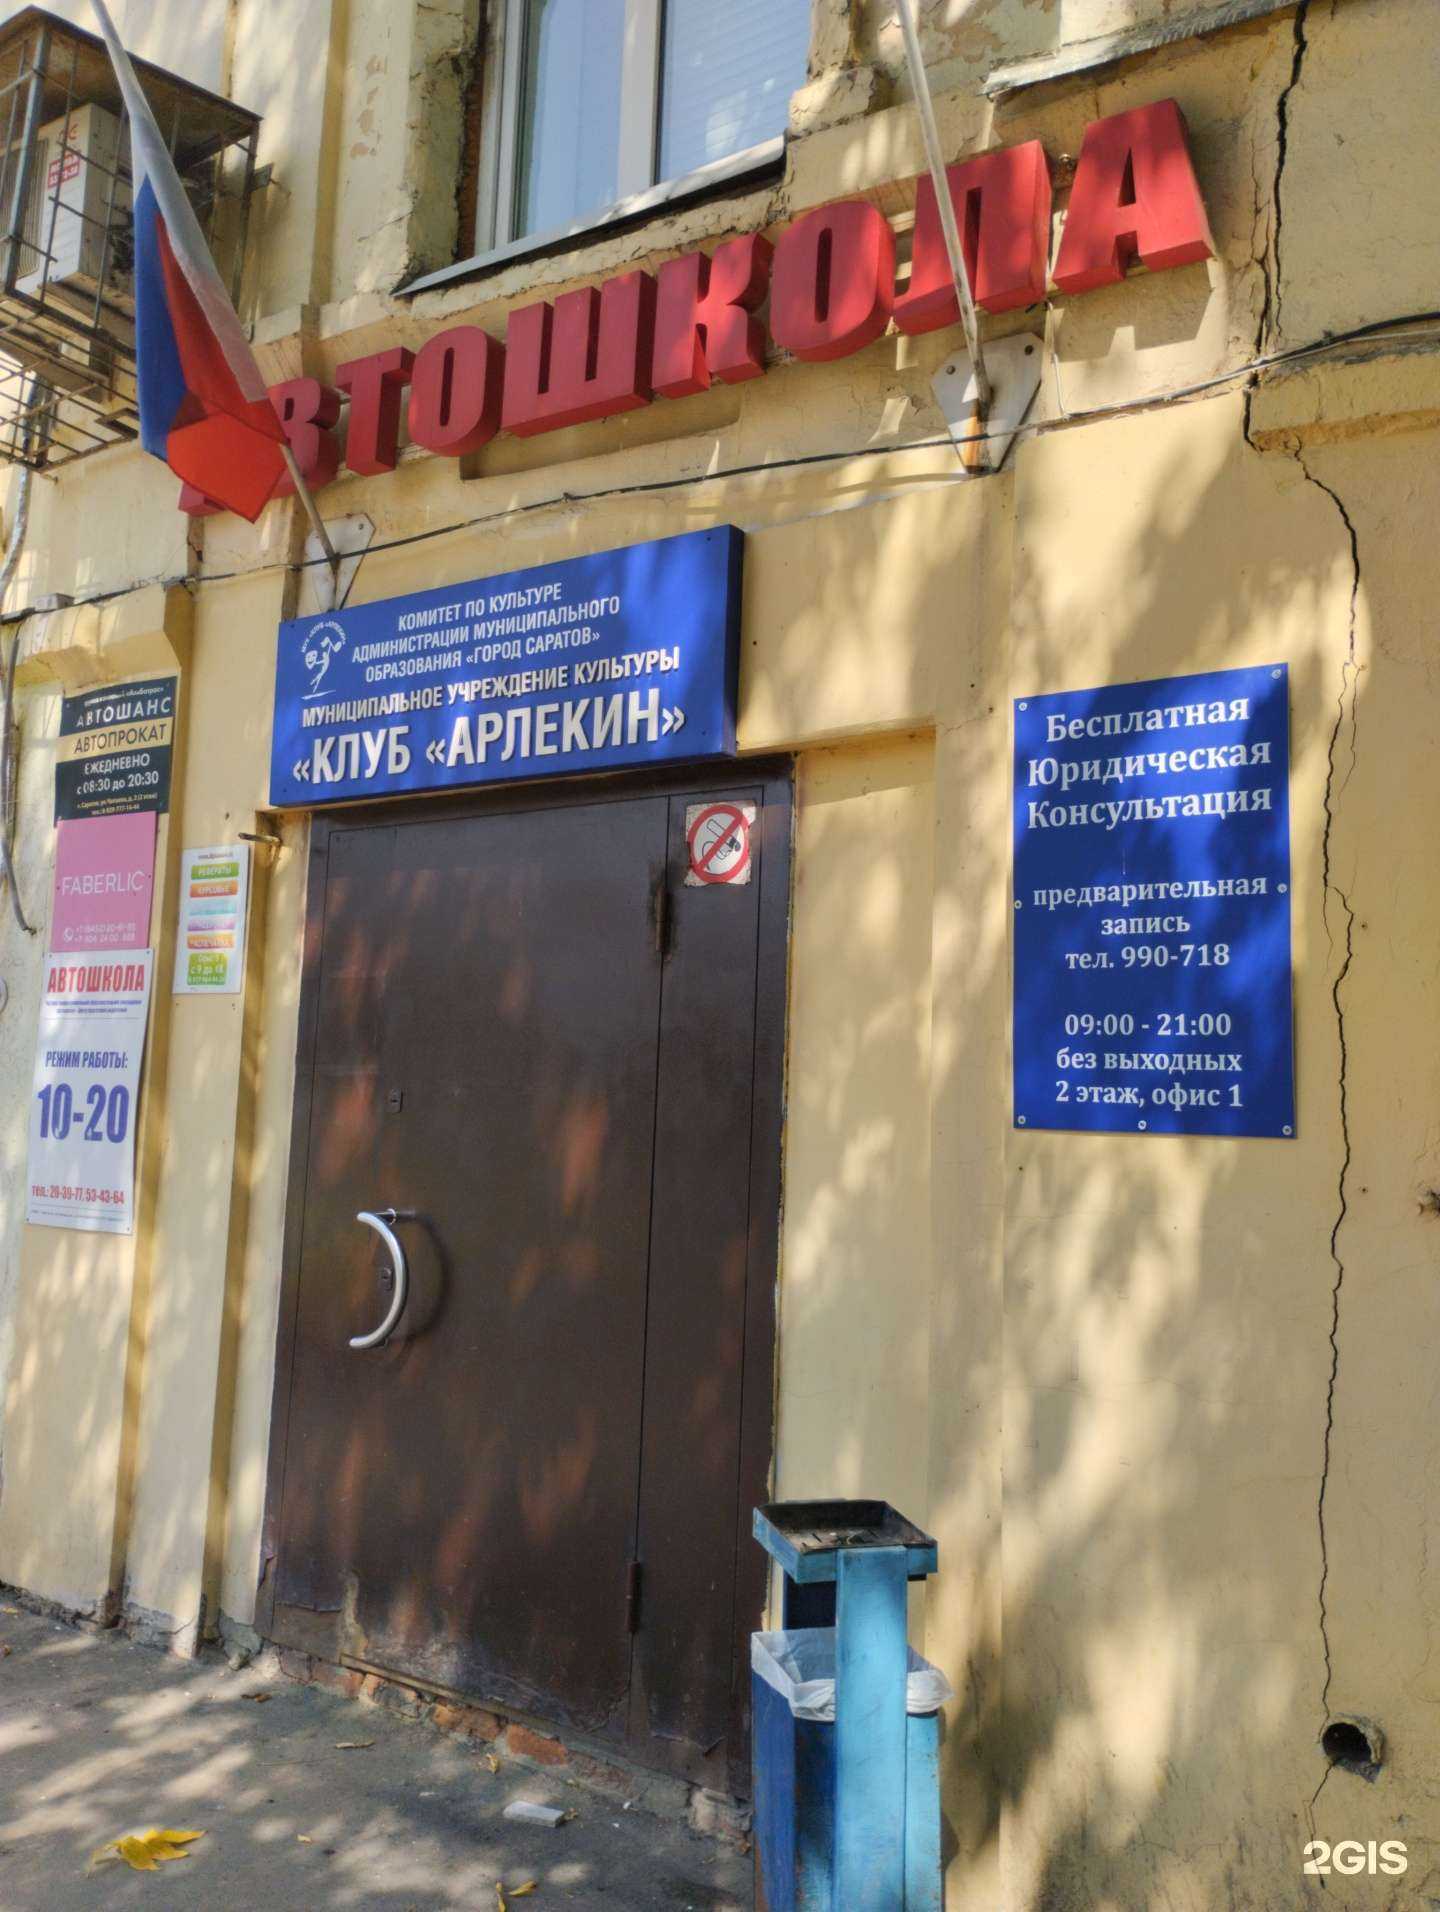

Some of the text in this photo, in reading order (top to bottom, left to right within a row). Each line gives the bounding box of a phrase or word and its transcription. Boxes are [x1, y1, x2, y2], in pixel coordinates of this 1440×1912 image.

[178, 97, 1215, 517] ВТОШКОЛА
[398, 583, 562, 632] КОМИТЕТ ПО КУЛЬТУРЕ
[352, 629, 470, 664] АДМИНИСТРАЦИИ
[473, 596, 620, 638] МУНИЦИПАЛЬНОГО
[365, 626, 601, 683] ОБРАЗОВАНИЯ «ГОРОД САРАТОВ»
[302, 646, 680, 728] МУНИЦИПАЛЬНОЕ УЧРЕЖДЕНИЕ КУЛЬТУРЫ
[76, 696, 171, 728] АВТОШАНС
[1046, 698, 1250, 742] Бесплатная
[74, 724, 167, 753] АВТОПРОКАТ
[293, 687, 688, 785] «КЛУБ «АРЛЕКИН»
[84, 753, 150, 775] ЕЖЕДНЕВНО
[1028, 741, 1272, 791] Юридическая
[76, 771, 159, 795] с 08:30 до 20:30
[1027, 788, 1272, 830] Консультация
[62, 870, 145, 896] FABERLIC
[1033, 877, 1267, 910] предварительная
[1101, 916, 1191, 936] запись
[1065, 943, 1230, 969] тел. 990-718
[47, 965, 144, 993] АВТОШКОЛА
[1064, 1013, 1134, 1036] 09:00
[1157, 1013, 1232, 1036] 21:00
[45, 1051, 128, 1069] РЕЖИМ РАБОТЫ:
[1056, 1047, 1243, 1075] без выходных
[1055, 1080, 1243, 1111] 2 этаж, офис 1
[38, 1083, 129, 1143] 10-20
